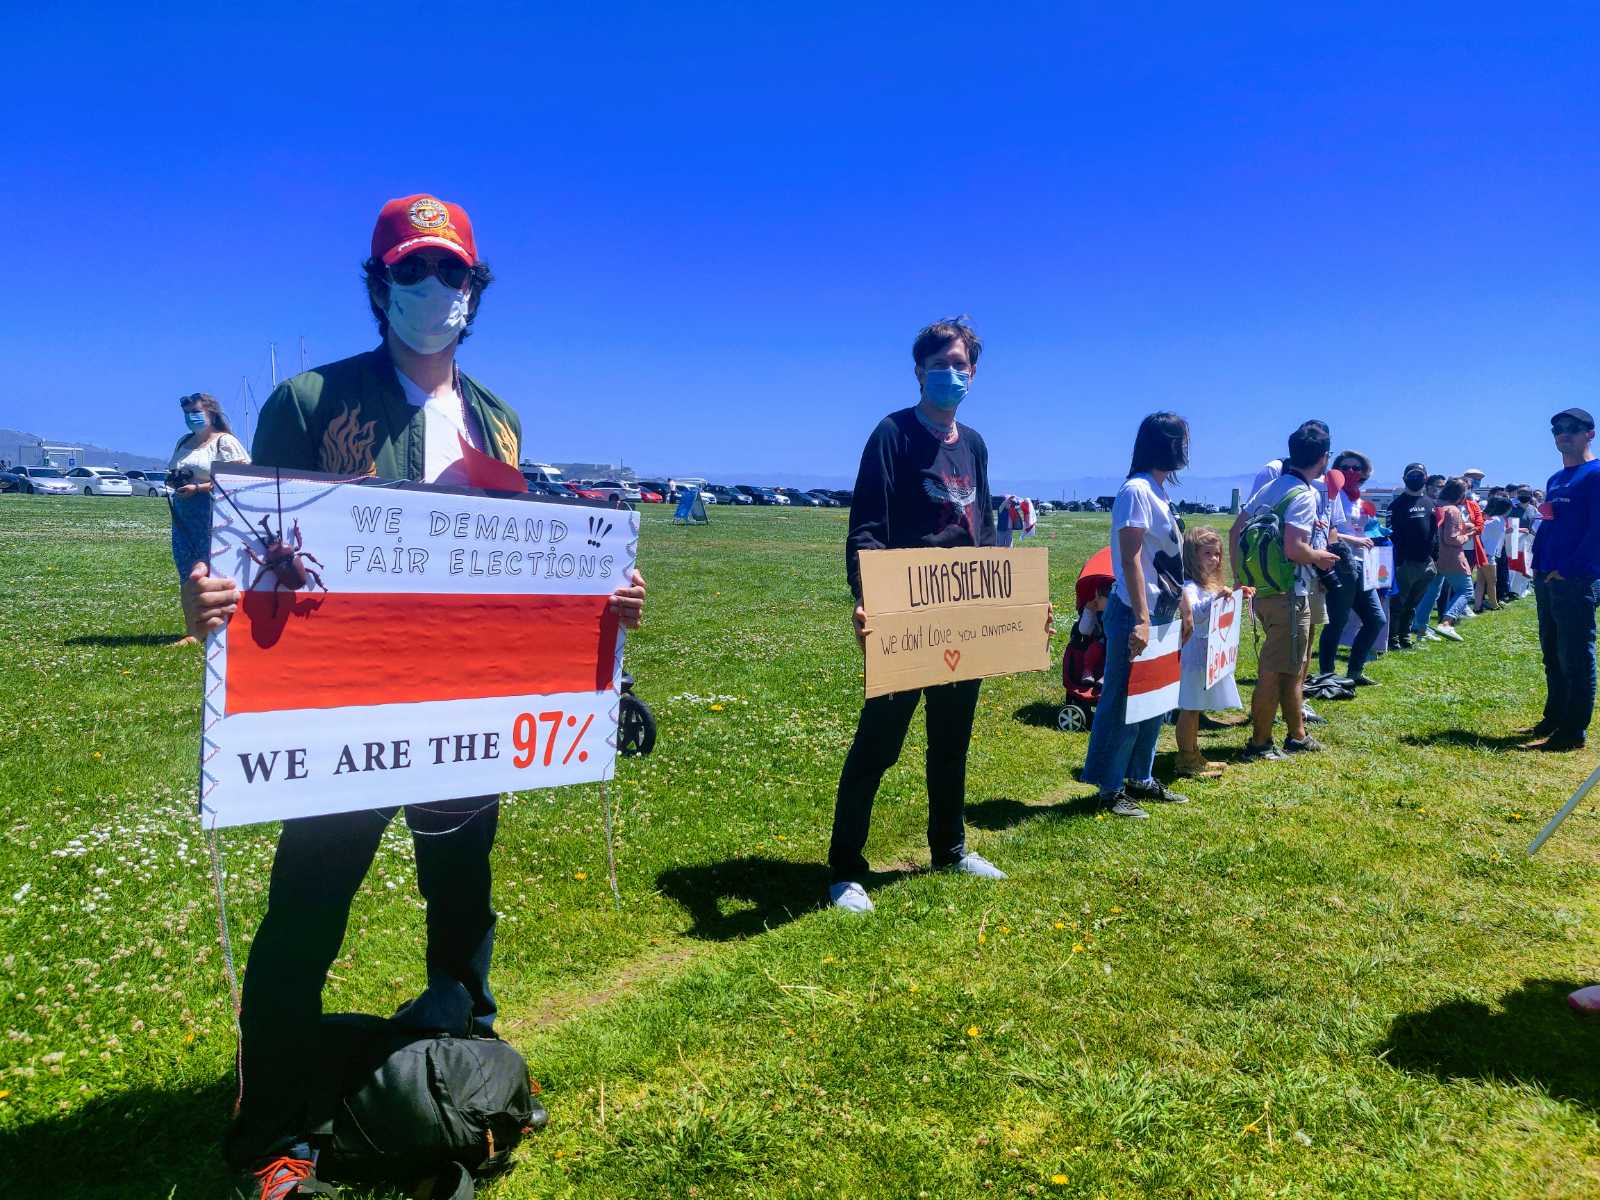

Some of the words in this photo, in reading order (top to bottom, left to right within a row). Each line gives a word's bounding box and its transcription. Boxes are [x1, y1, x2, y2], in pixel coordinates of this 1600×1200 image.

[352, 505, 403, 534] WE
[429, 510, 568, 544] DEMAND
[346, 536, 430, 574] FAIR
[449, 545, 614, 578] ELECTIONS
[907, 559, 1013, 608] LUKASHENKO
[237, 747, 308, 785] WE
[332, 738, 412, 775] ARE
[428, 730, 500, 764] THE
[512, 711, 594, 769] 97%
